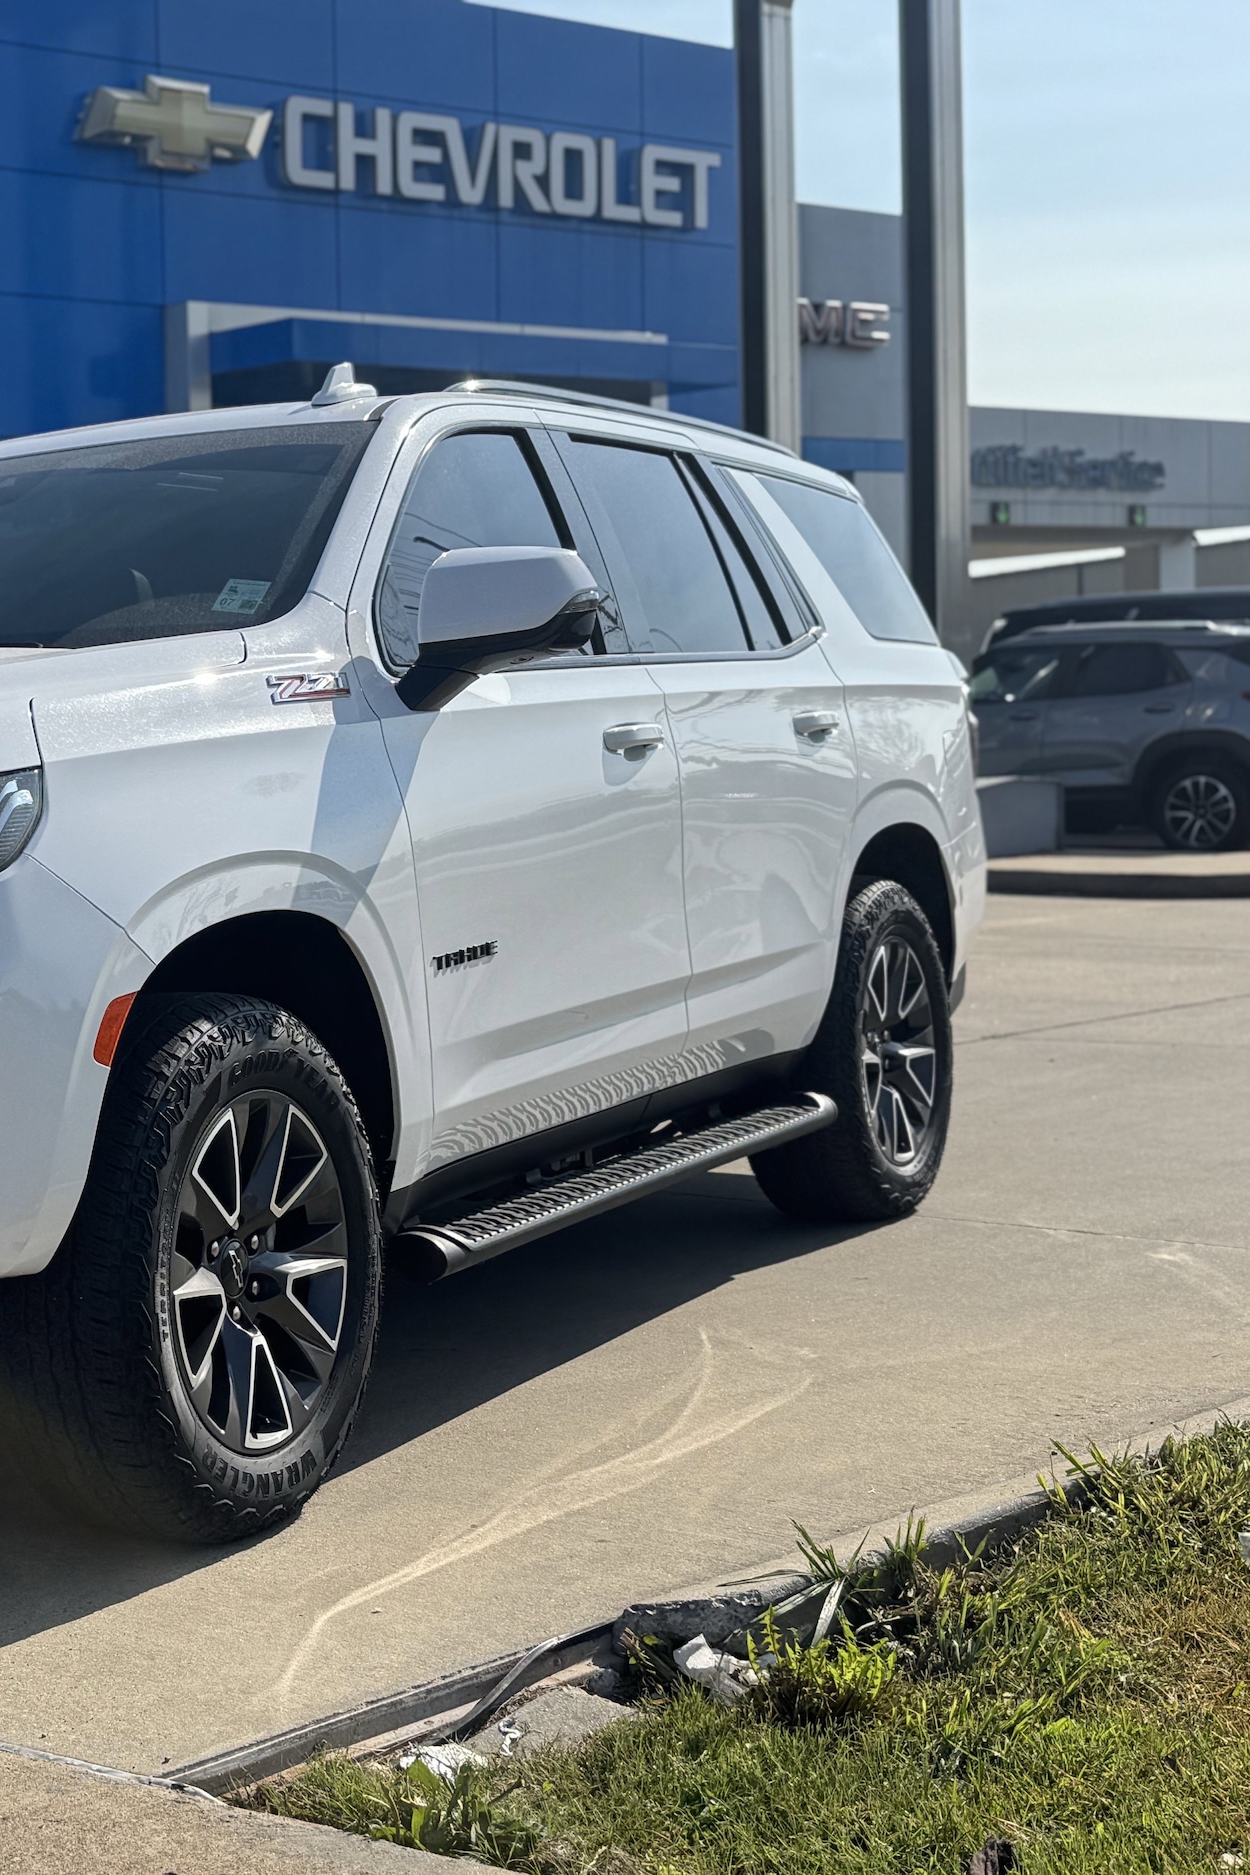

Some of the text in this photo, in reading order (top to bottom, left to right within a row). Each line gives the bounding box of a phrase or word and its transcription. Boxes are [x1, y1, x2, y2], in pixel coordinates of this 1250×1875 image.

[282, 95, 721, 230] CHEVROLET
[796, 297, 891, 348] MC
[266, 672, 350, 706] Z71
[432, 940, 498, 971] TAHOE
[202, 1442, 318, 1499] WRANGLER
